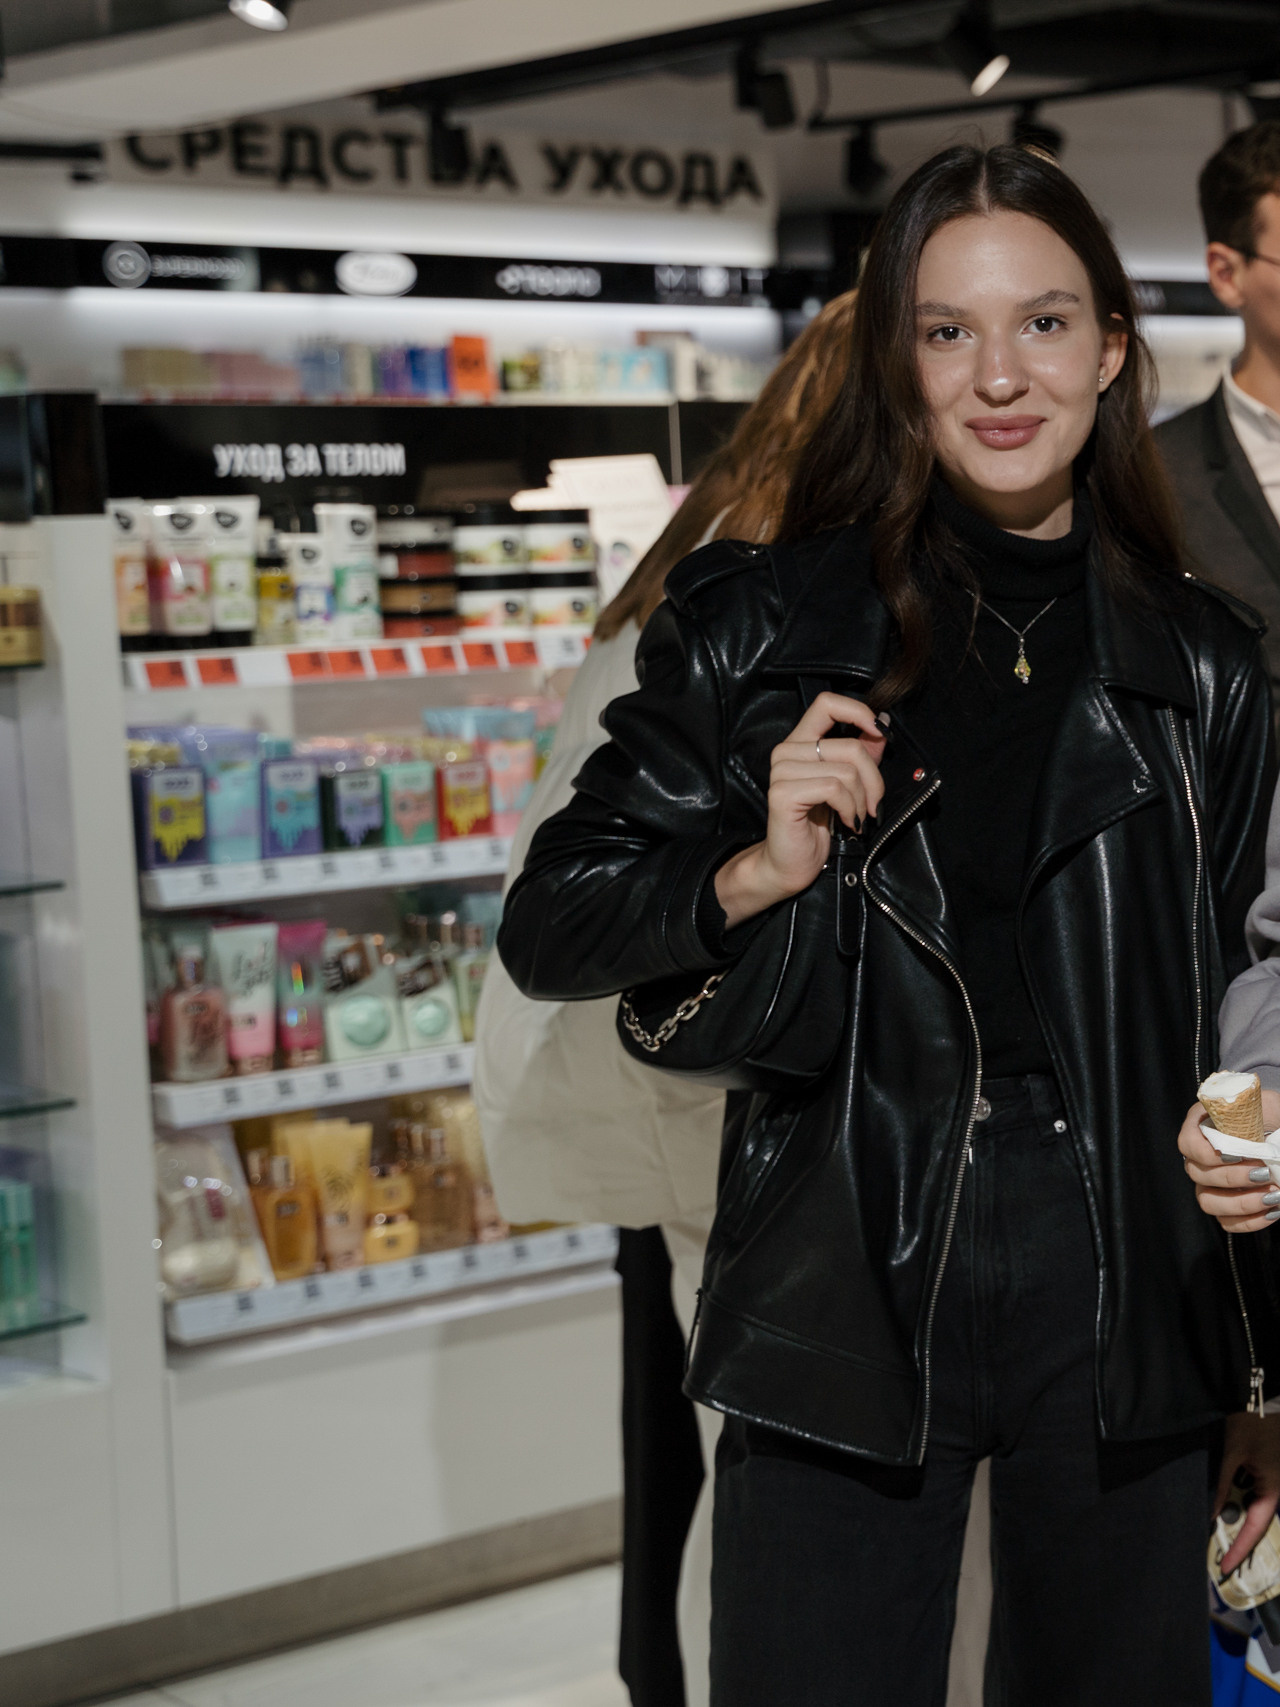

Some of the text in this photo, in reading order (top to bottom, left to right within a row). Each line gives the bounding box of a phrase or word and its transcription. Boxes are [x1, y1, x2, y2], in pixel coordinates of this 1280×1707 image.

[124, 119, 766, 211] СРЕДСТА УХОДА
[212, 443, 406, 483] УХОД ЗА ТЕЛОМ
